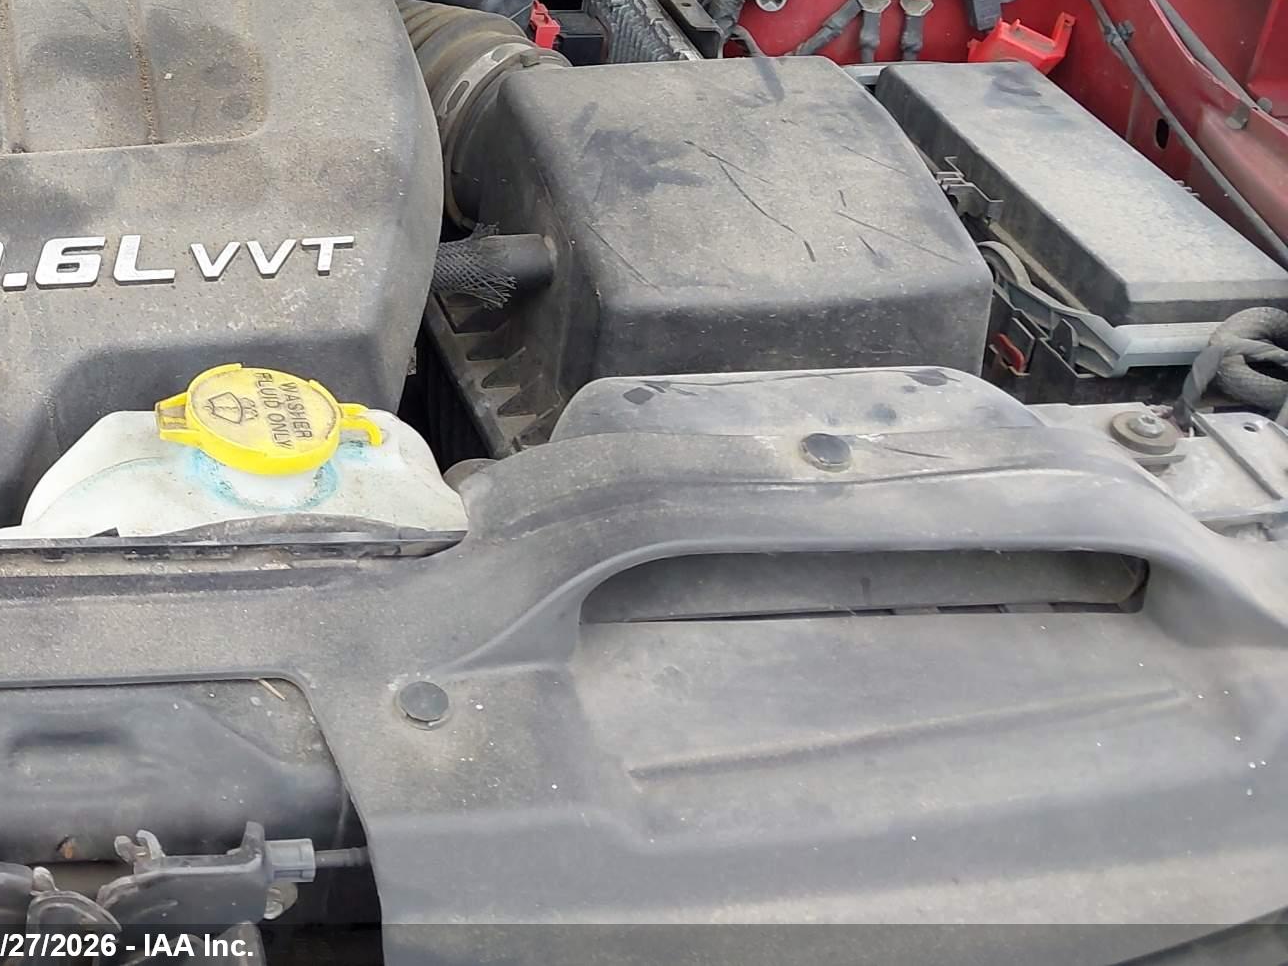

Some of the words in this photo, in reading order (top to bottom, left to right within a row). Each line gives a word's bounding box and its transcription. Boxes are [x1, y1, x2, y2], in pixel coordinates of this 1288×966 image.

[191, 236, 355, 281] VVT
[255, 372, 280, 409] FLUID
[269, 413, 295, 449] ONLY
[280, 381, 313, 439] WASHER
